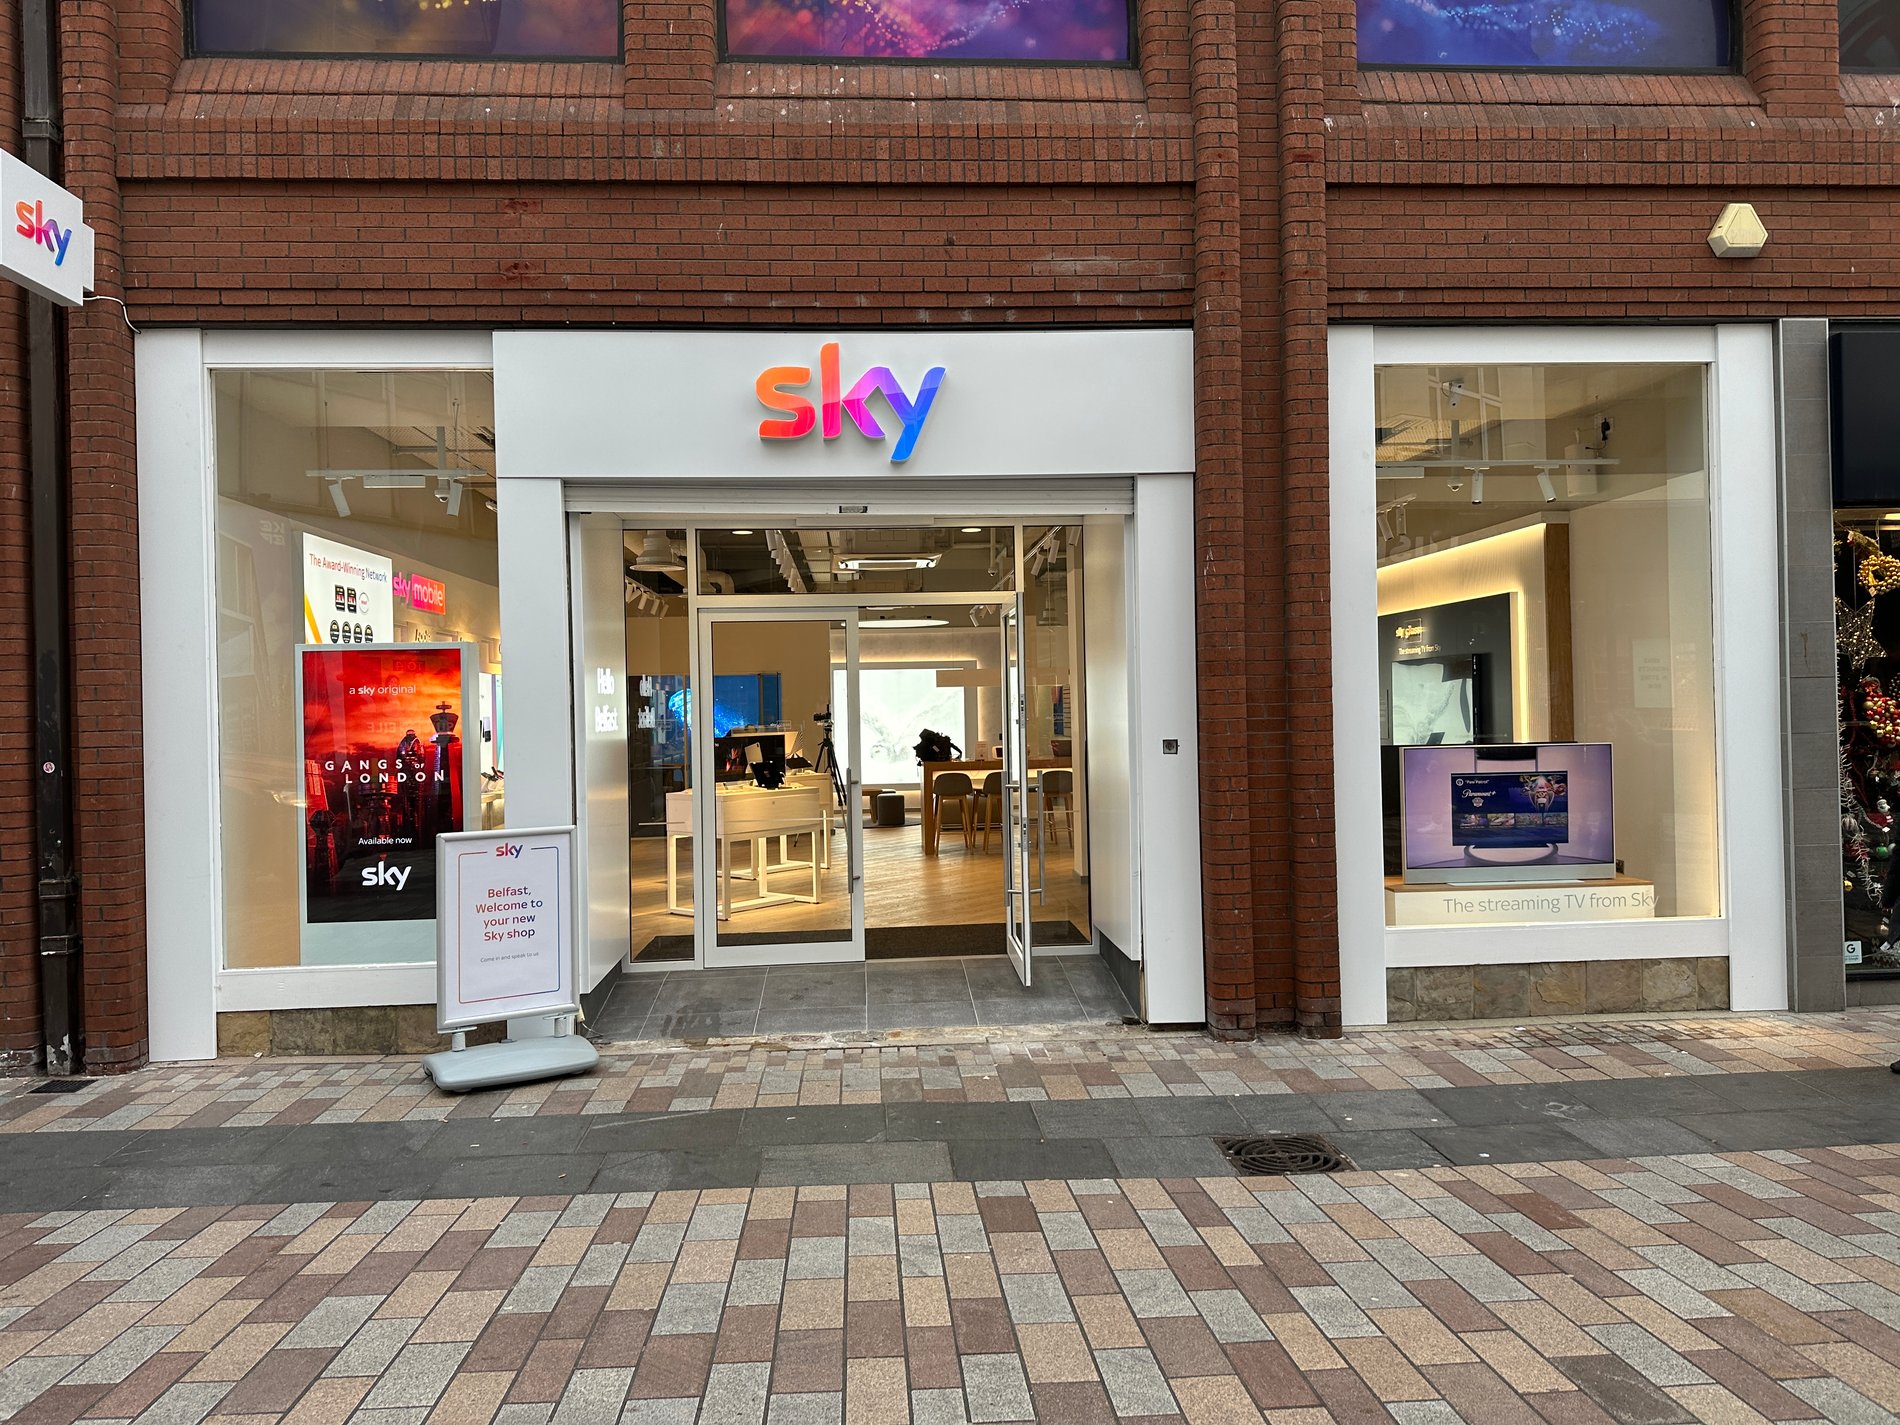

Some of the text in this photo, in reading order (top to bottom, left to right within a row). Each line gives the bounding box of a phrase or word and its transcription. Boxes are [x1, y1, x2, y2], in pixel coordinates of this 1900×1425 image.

[16, 200, 72, 266] sky
[755, 341, 946, 462] sky
[309, 553, 387, 582] The Award-Winning Network
[393, 572, 443, 607] sky mobile
[358, 686, 374, 696] sky
[378, 685, 416, 695] original
[325, 759, 403, 773] GANGS
[345, 769, 444, 784] LONDON
[358, 836, 412, 845] Available now
[496, 842, 523, 858] sky
[361, 861, 412, 891] sky
[487, 886, 531, 898] Belfast,
[476, 899, 543, 913] Welcome to
[1443, 892, 1659, 913] The streaming TV from Sky
[484, 914, 536, 929] your new
[484, 928, 536, 942] Sky shop
